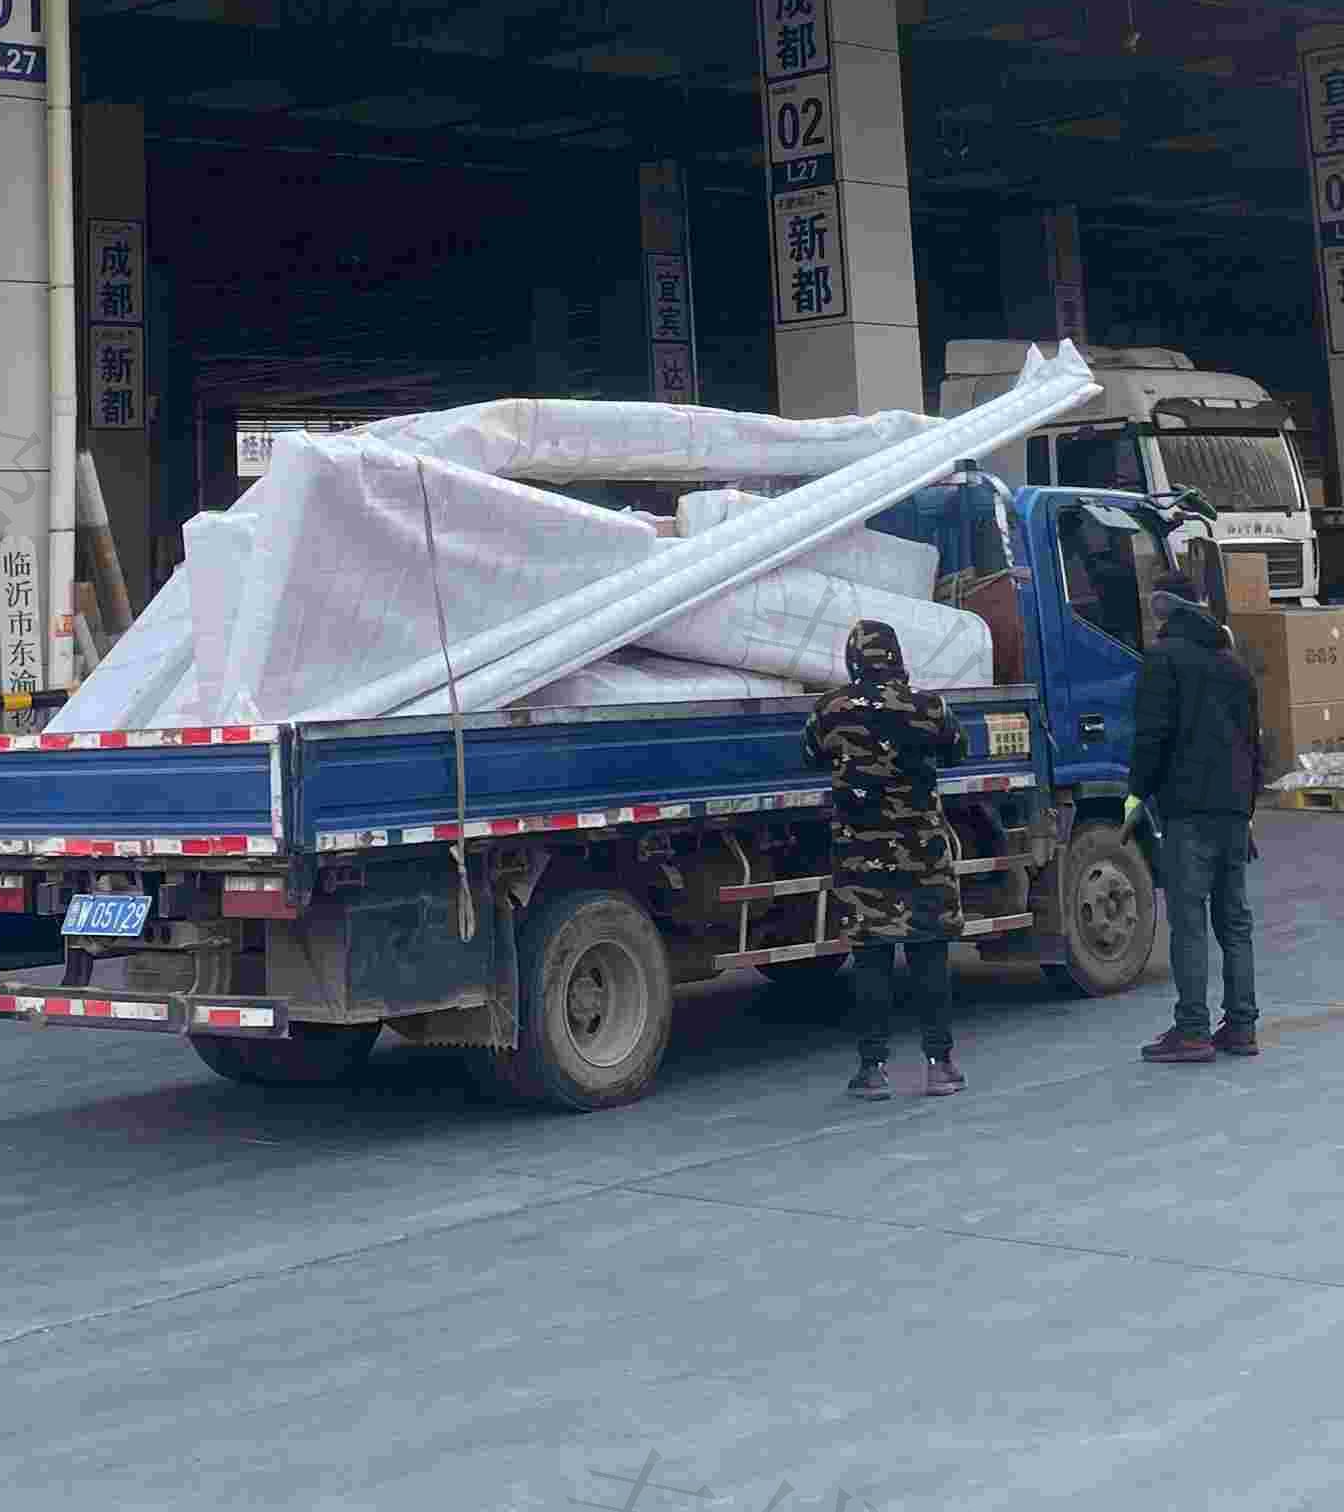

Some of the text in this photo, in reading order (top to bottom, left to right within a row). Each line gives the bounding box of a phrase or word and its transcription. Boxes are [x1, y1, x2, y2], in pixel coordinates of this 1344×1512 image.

[777, 97, 825, 150] 02
[786, 161, 817, 183] L27
[787, 212, 833, 312] 新都
